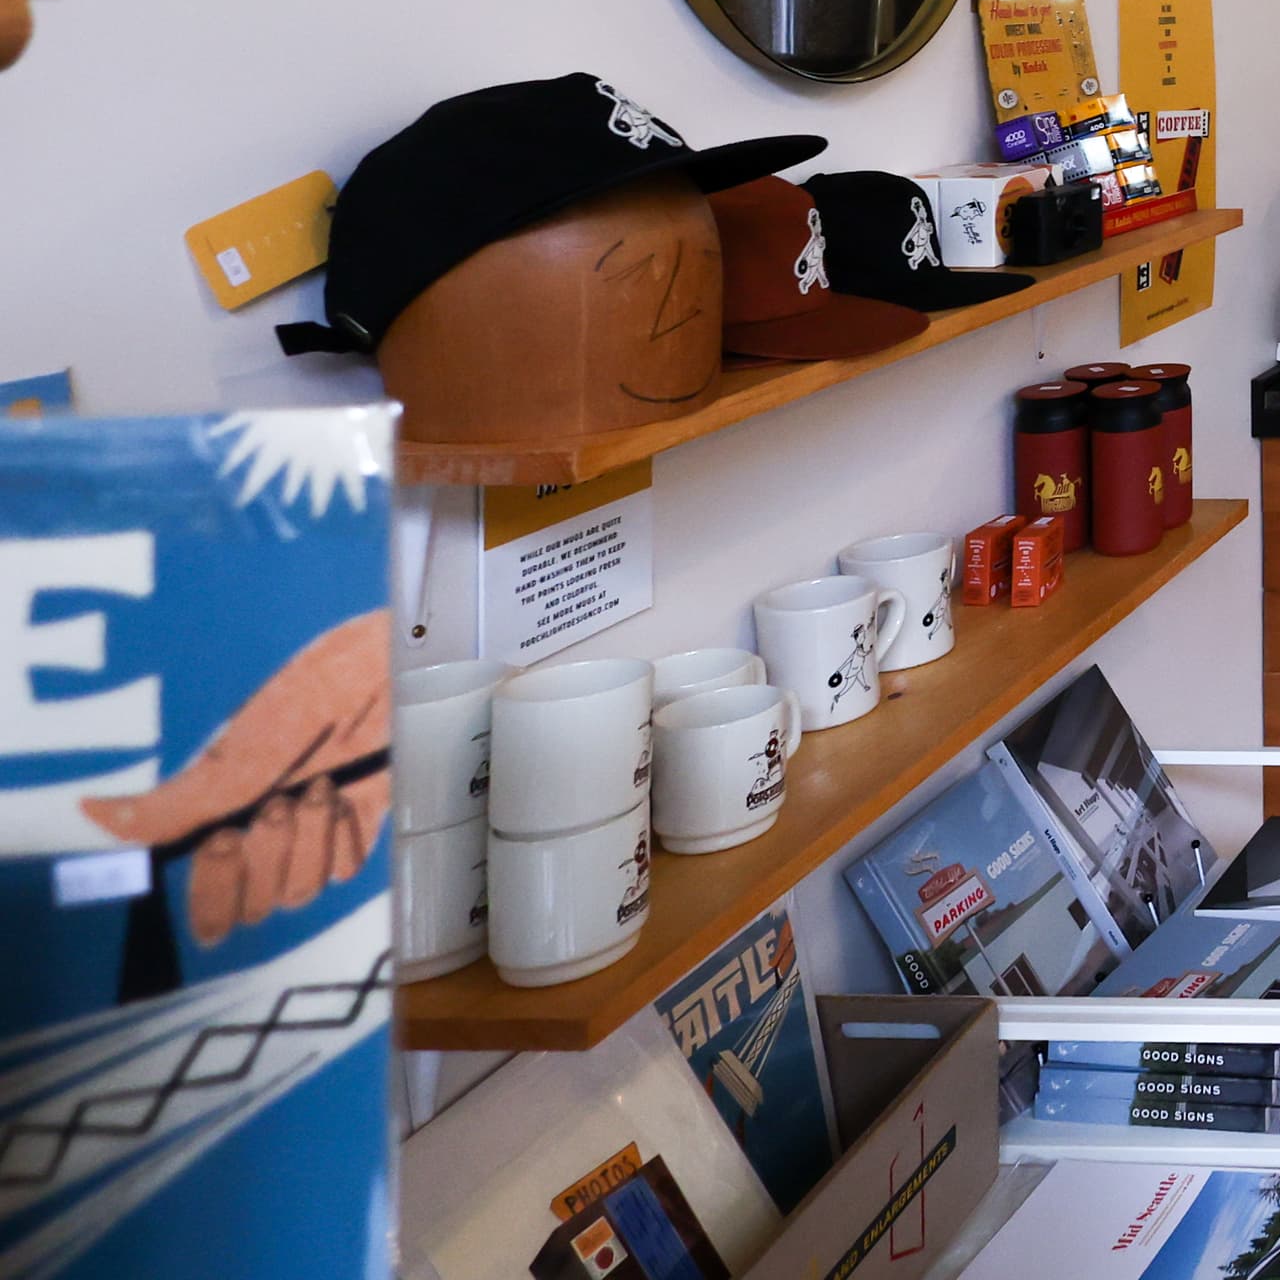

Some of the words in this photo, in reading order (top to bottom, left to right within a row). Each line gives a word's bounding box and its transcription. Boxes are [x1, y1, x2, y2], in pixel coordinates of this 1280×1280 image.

[1022, 60, 1048, 74] Kodak
[1090, 122, 1105, 132] 400
[1158, 114, 1202, 133] COFFEE
[520, 548, 543, 563] WHILE
[545, 541, 561, 553] OUR
[562, 531, 583, 546] MUGS
[585, 525, 599, 536] ARE
[601, 516, 622, 532] QUITE
[560, 551, 571, 561] WE
[573, 532, 618, 558] RECOMMEND
[515, 579, 536, 594] HAND
[539, 564, 574, 583] WASHING
[575, 555, 595, 569] THEM
[597, 550, 606, 561] TO
[608, 541, 626, 555] KEEP
[521, 594, 535, 606] THE
[538, 582, 564, 599] PRINTS
[566, 570, 597, 587] LOOKING
[599, 557, 621, 573] FRESH
[520, 598, 620, 649] PORCHLIGHTDESIGNCO.COM
[537, 615, 550, 628] SEE
[552, 606, 574, 620] MORE
[576, 595, 596, 611] MUGS
[598, 590, 607, 600] AT
[545, 598, 560, 610] AND
[0, 532, 160, 856] E
[986, 851, 1012, 879] GOOD
[1009, 830, 1035, 859] SIGNS
[934, 887, 985, 933] PARKING
[660, 928, 777, 1060] ATTLE
[904, 954, 928, 989] GOOD
[1142, 1050, 1179, 1062] GOOD
[1184, 1052, 1224, 1066] SIGNS
[1137, 1082, 1175, 1093] GOOD
[1180, 1083, 1221, 1096] SIGNS
[1132, 1108, 1169, 1120] GOOD
[1174, 1110, 1214, 1122] SIGNS
[564, 1155, 637, 1215] PHOTOS
[863, 1143, 950, 1249] ENLARGEMENTS
[1112, 1224, 1143, 1250] Mid
[1136, 1172, 1177, 1220] Seattle
